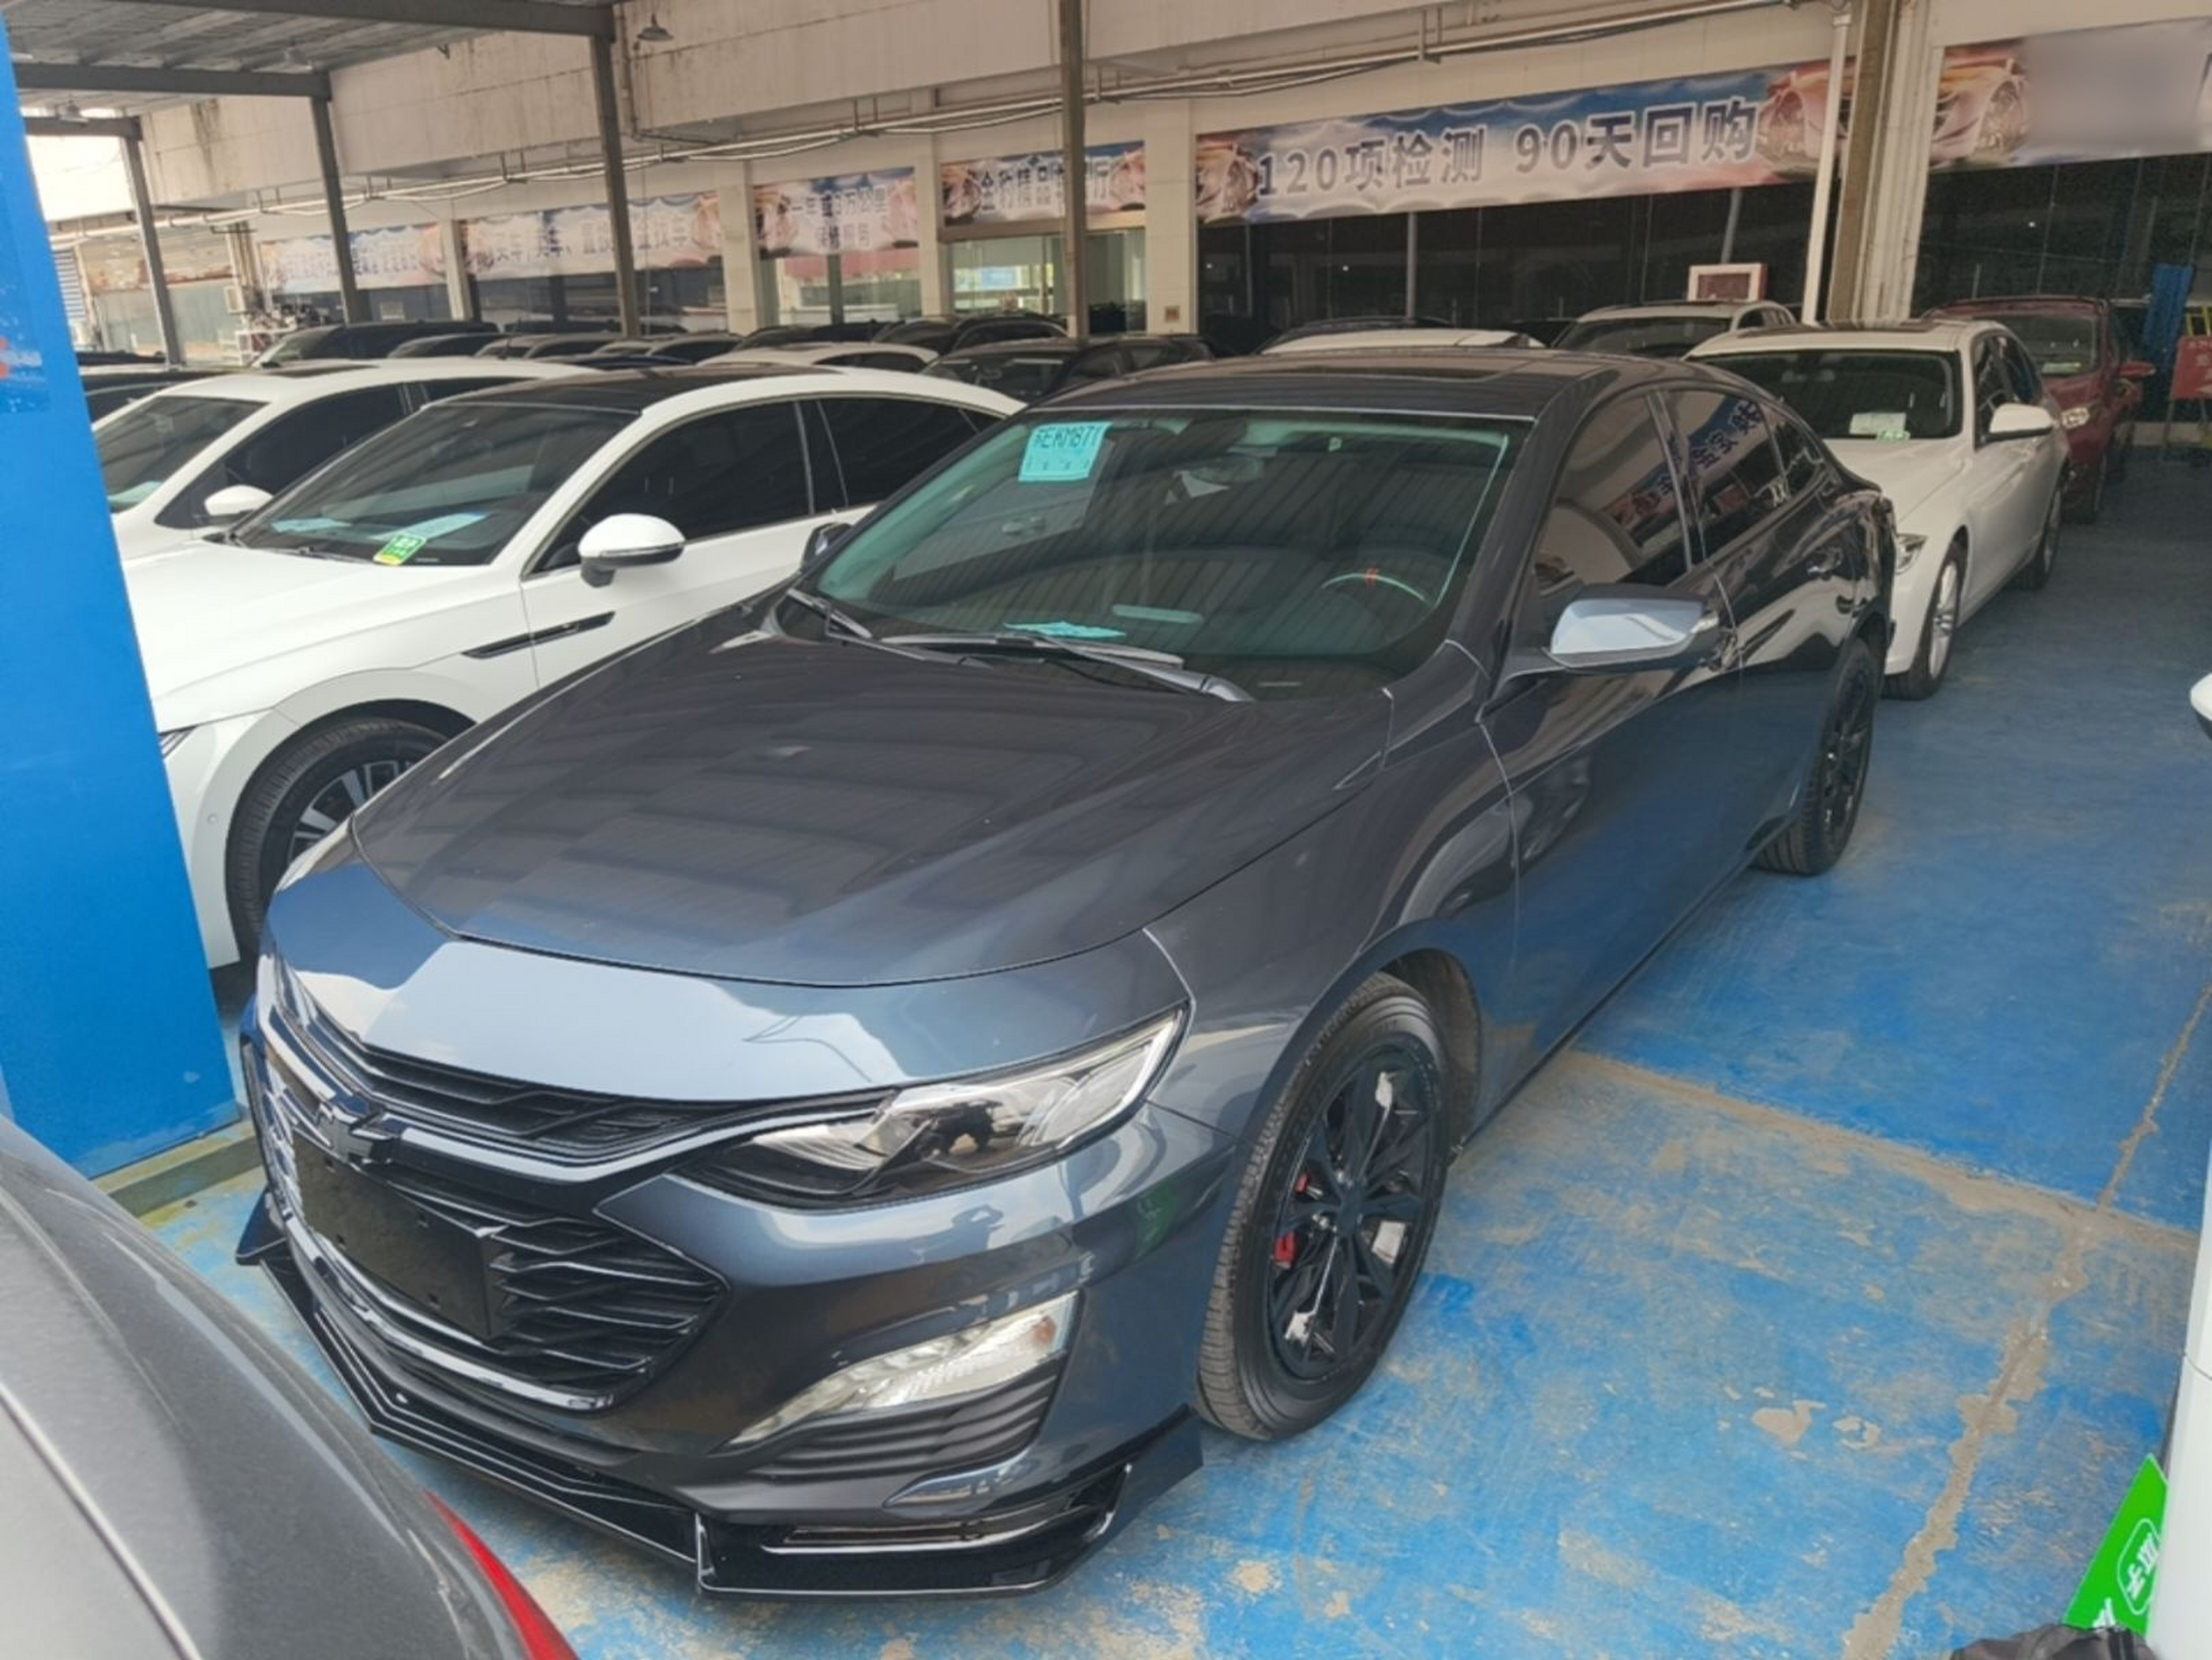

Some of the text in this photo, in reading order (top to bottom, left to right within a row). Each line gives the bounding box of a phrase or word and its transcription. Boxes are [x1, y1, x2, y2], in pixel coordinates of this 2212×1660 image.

[1258, 100, 1758, 196] 120项检测 90天回购
